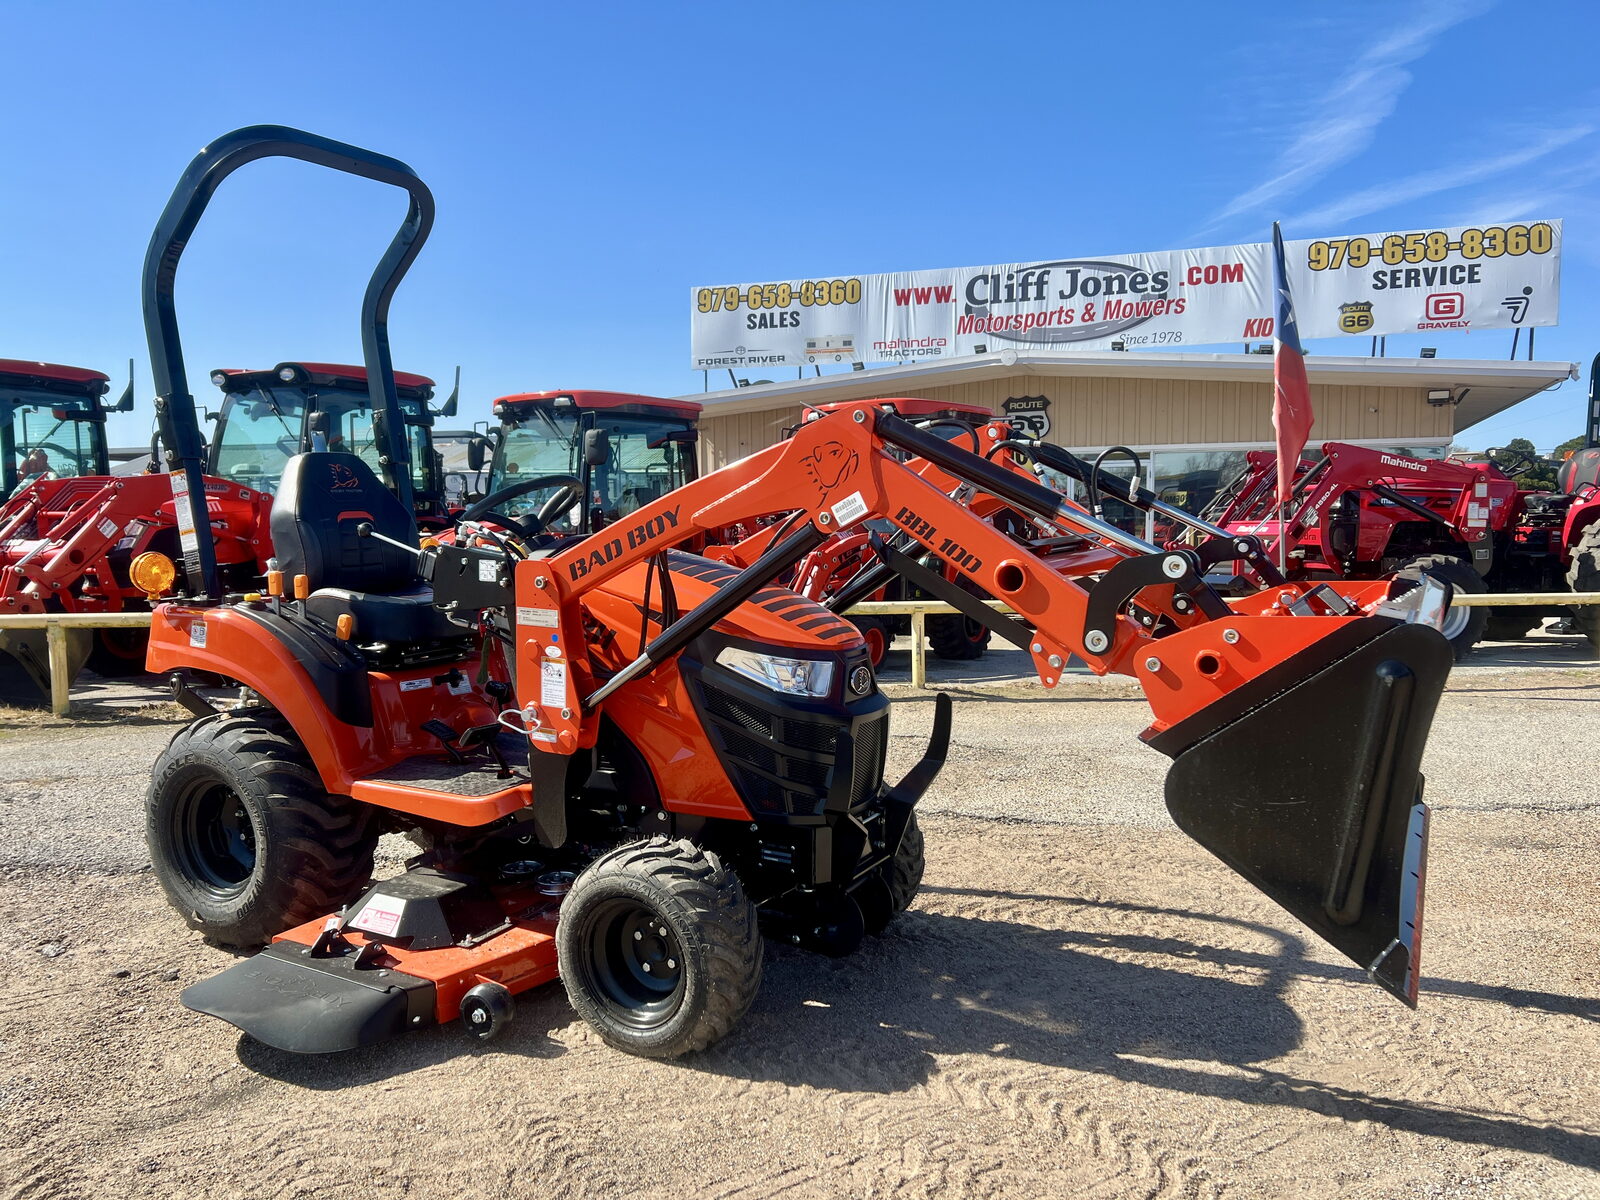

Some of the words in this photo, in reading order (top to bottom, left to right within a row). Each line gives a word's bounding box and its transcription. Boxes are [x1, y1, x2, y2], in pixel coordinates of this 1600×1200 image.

[1308, 223, 1553, 271] 979-658-8360
[1179, 263, 1244, 287] .COM
[1372, 263, 1481, 290] SERVICE
[697, 279, 862, 313] 979-658-8360
[965, 269, 1052, 305] Cliff
[1058, 268, 1169, 300] Jones
[956, 305, 1075, 336] Motorsports
[1080, 302, 1097, 321] &
[1103, 297, 1186, 321] Mowers
[1343, 305, 1370, 313] ROUTE
[746, 311, 801, 330] SALES
[1242, 317, 1275, 338] KIO
[1342, 315, 1370, 328] 66
[1417, 320, 1471, 330] GRAVELY
[873, 336, 947, 351] mahindra
[1119, 332, 1149, 345] Since
[1151, 331, 1183, 344] 1978
[698, 357, 746, 366] FOREST
[748, 355, 786, 364] RIVER
[878, 347, 942, 358] TRACTORS
[1009, 400, 1044, 410] ROUTE
[1380, 454, 1428, 472] Mahindra
[568, 537, 624, 582] BAD
[628, 504, 681, 552] BOY
[894, 505, 936, 551] BBL
[938, 536, 983, 574] 100
[149, 753, 195, 834] CARLISLE
[626, 878, 699, 952] CARLISLE
